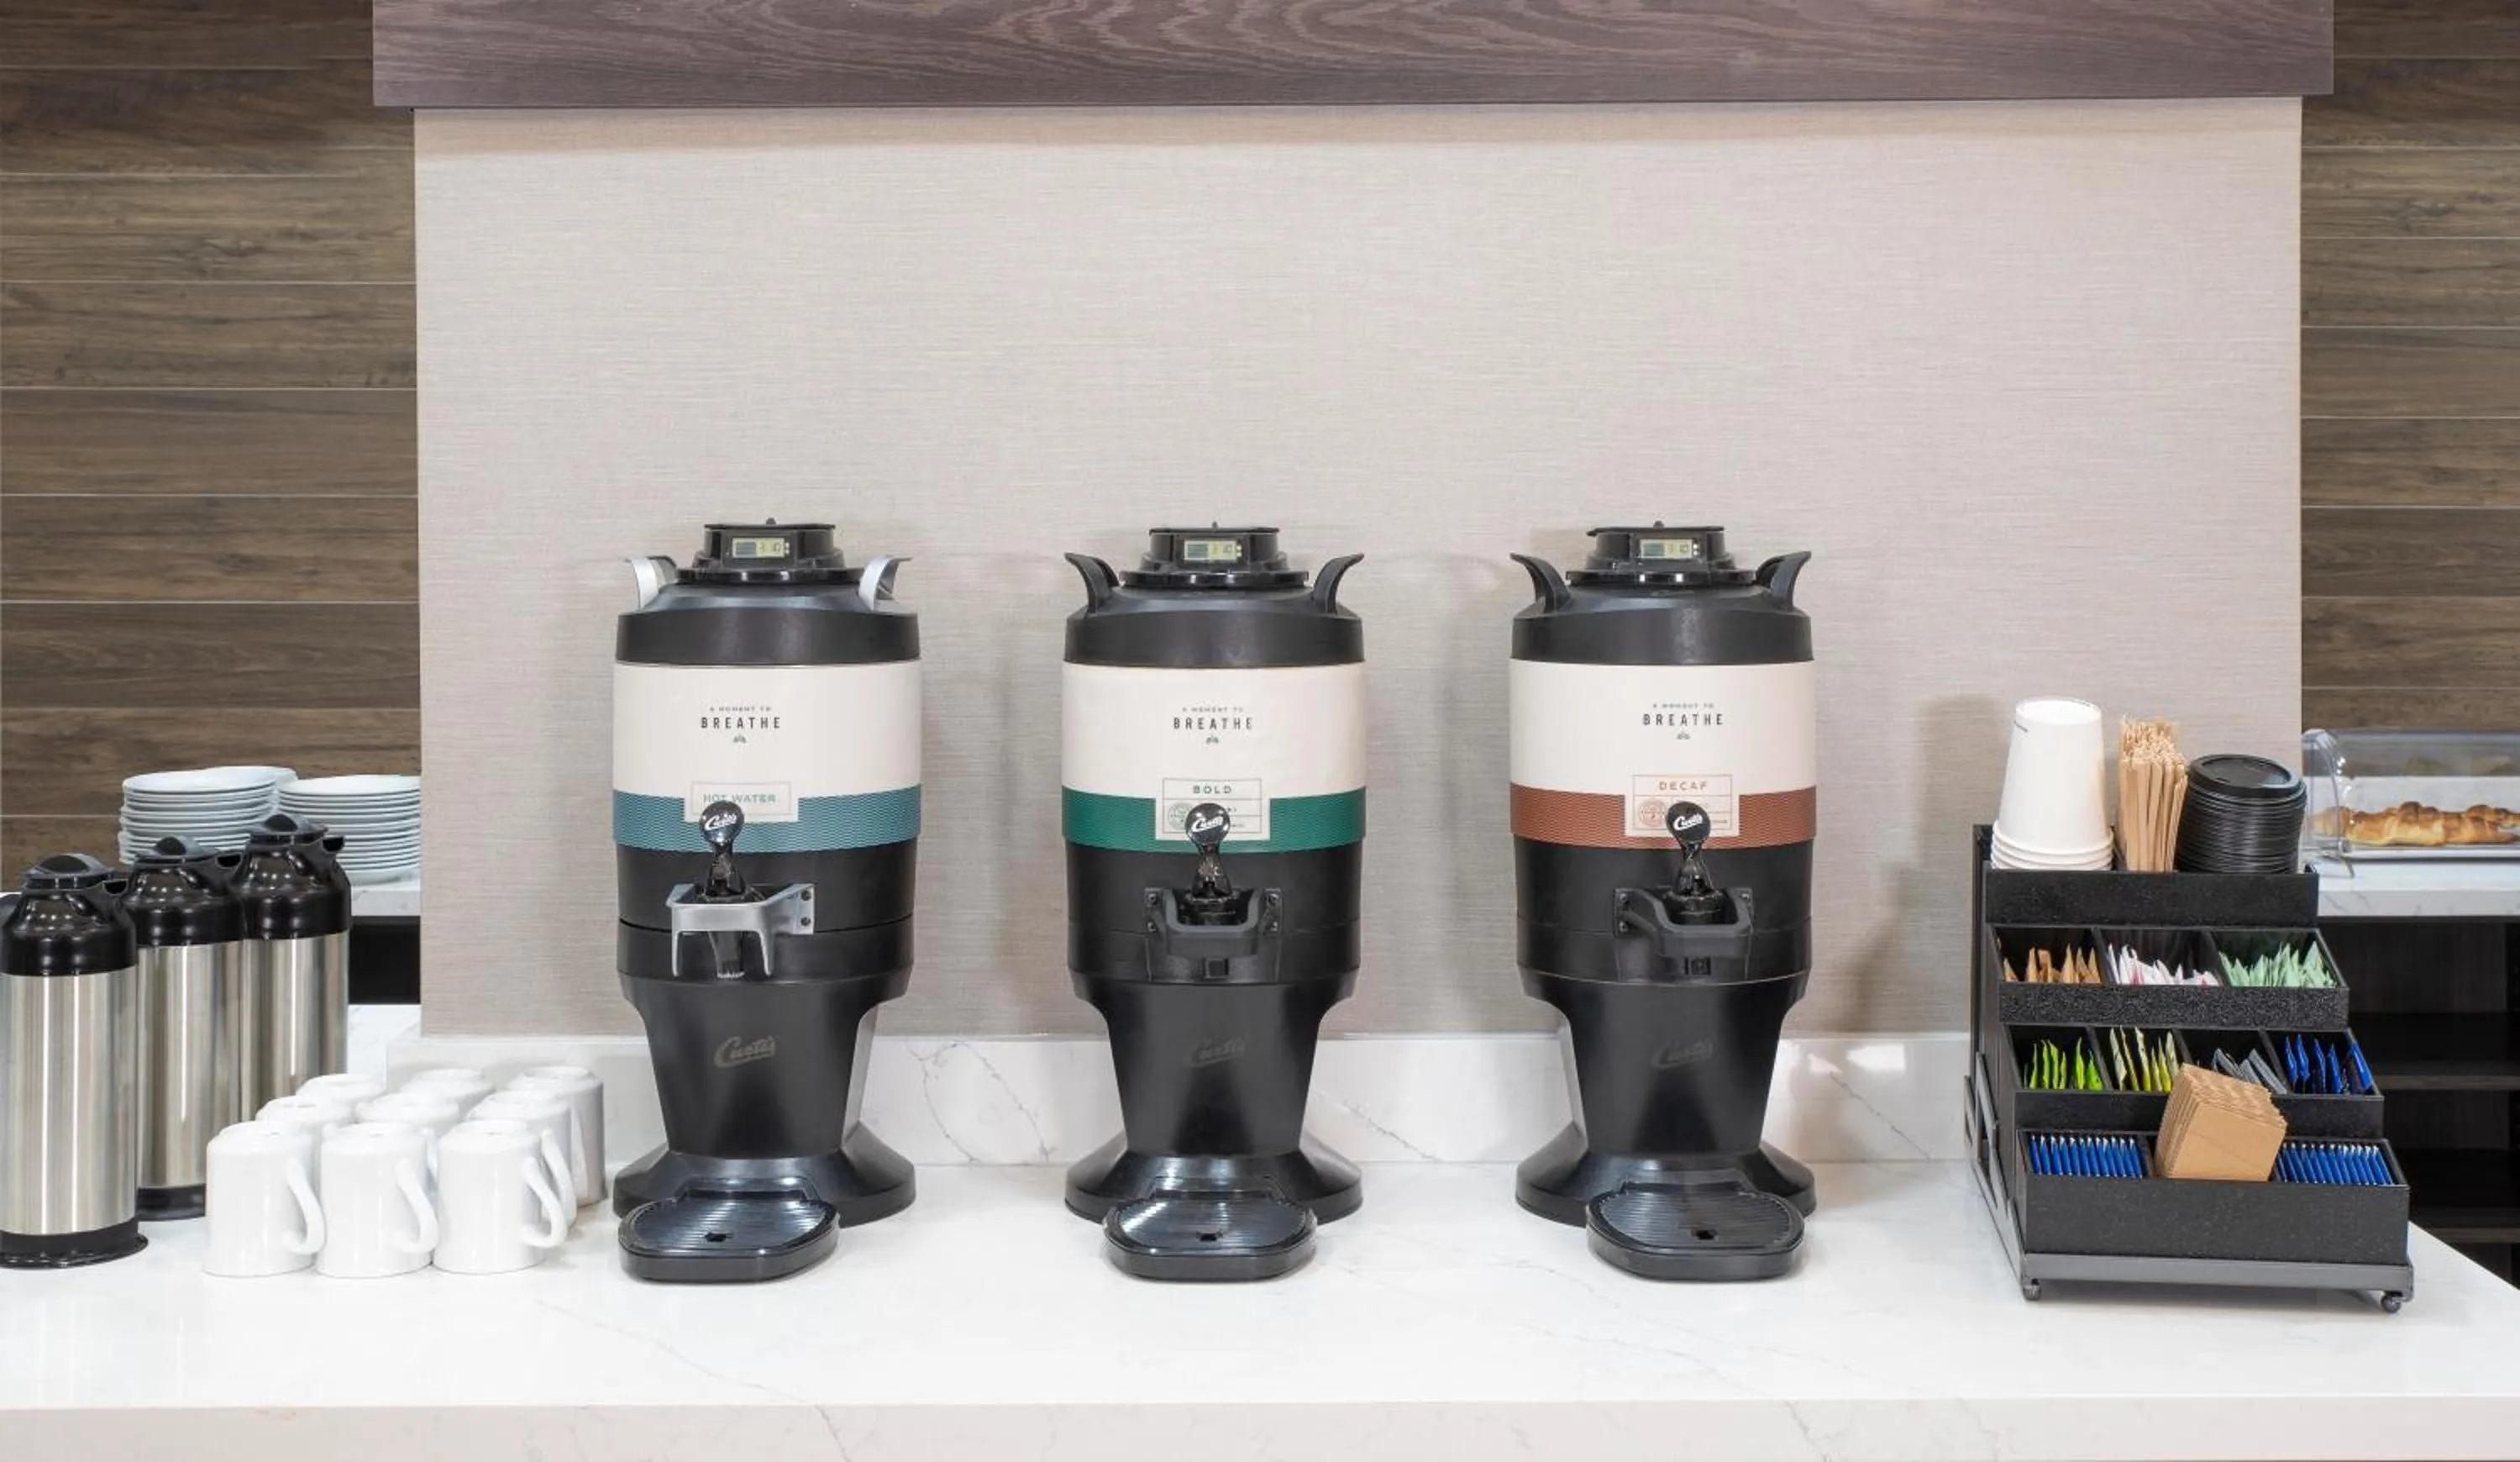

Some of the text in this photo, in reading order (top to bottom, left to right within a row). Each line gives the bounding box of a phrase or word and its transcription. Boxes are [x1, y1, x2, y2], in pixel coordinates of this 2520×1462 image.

[701, 717, 780, 729] BREATHE
[1173, 717, 1252, 730] BREATHE
[1642, 713, 1724, 726] BREATHE
[1193, 786, 1232, 794] BOLD
[1659, 781, 1708, 791] DECAF
[703, 793, 777, 804] HOT WATER
